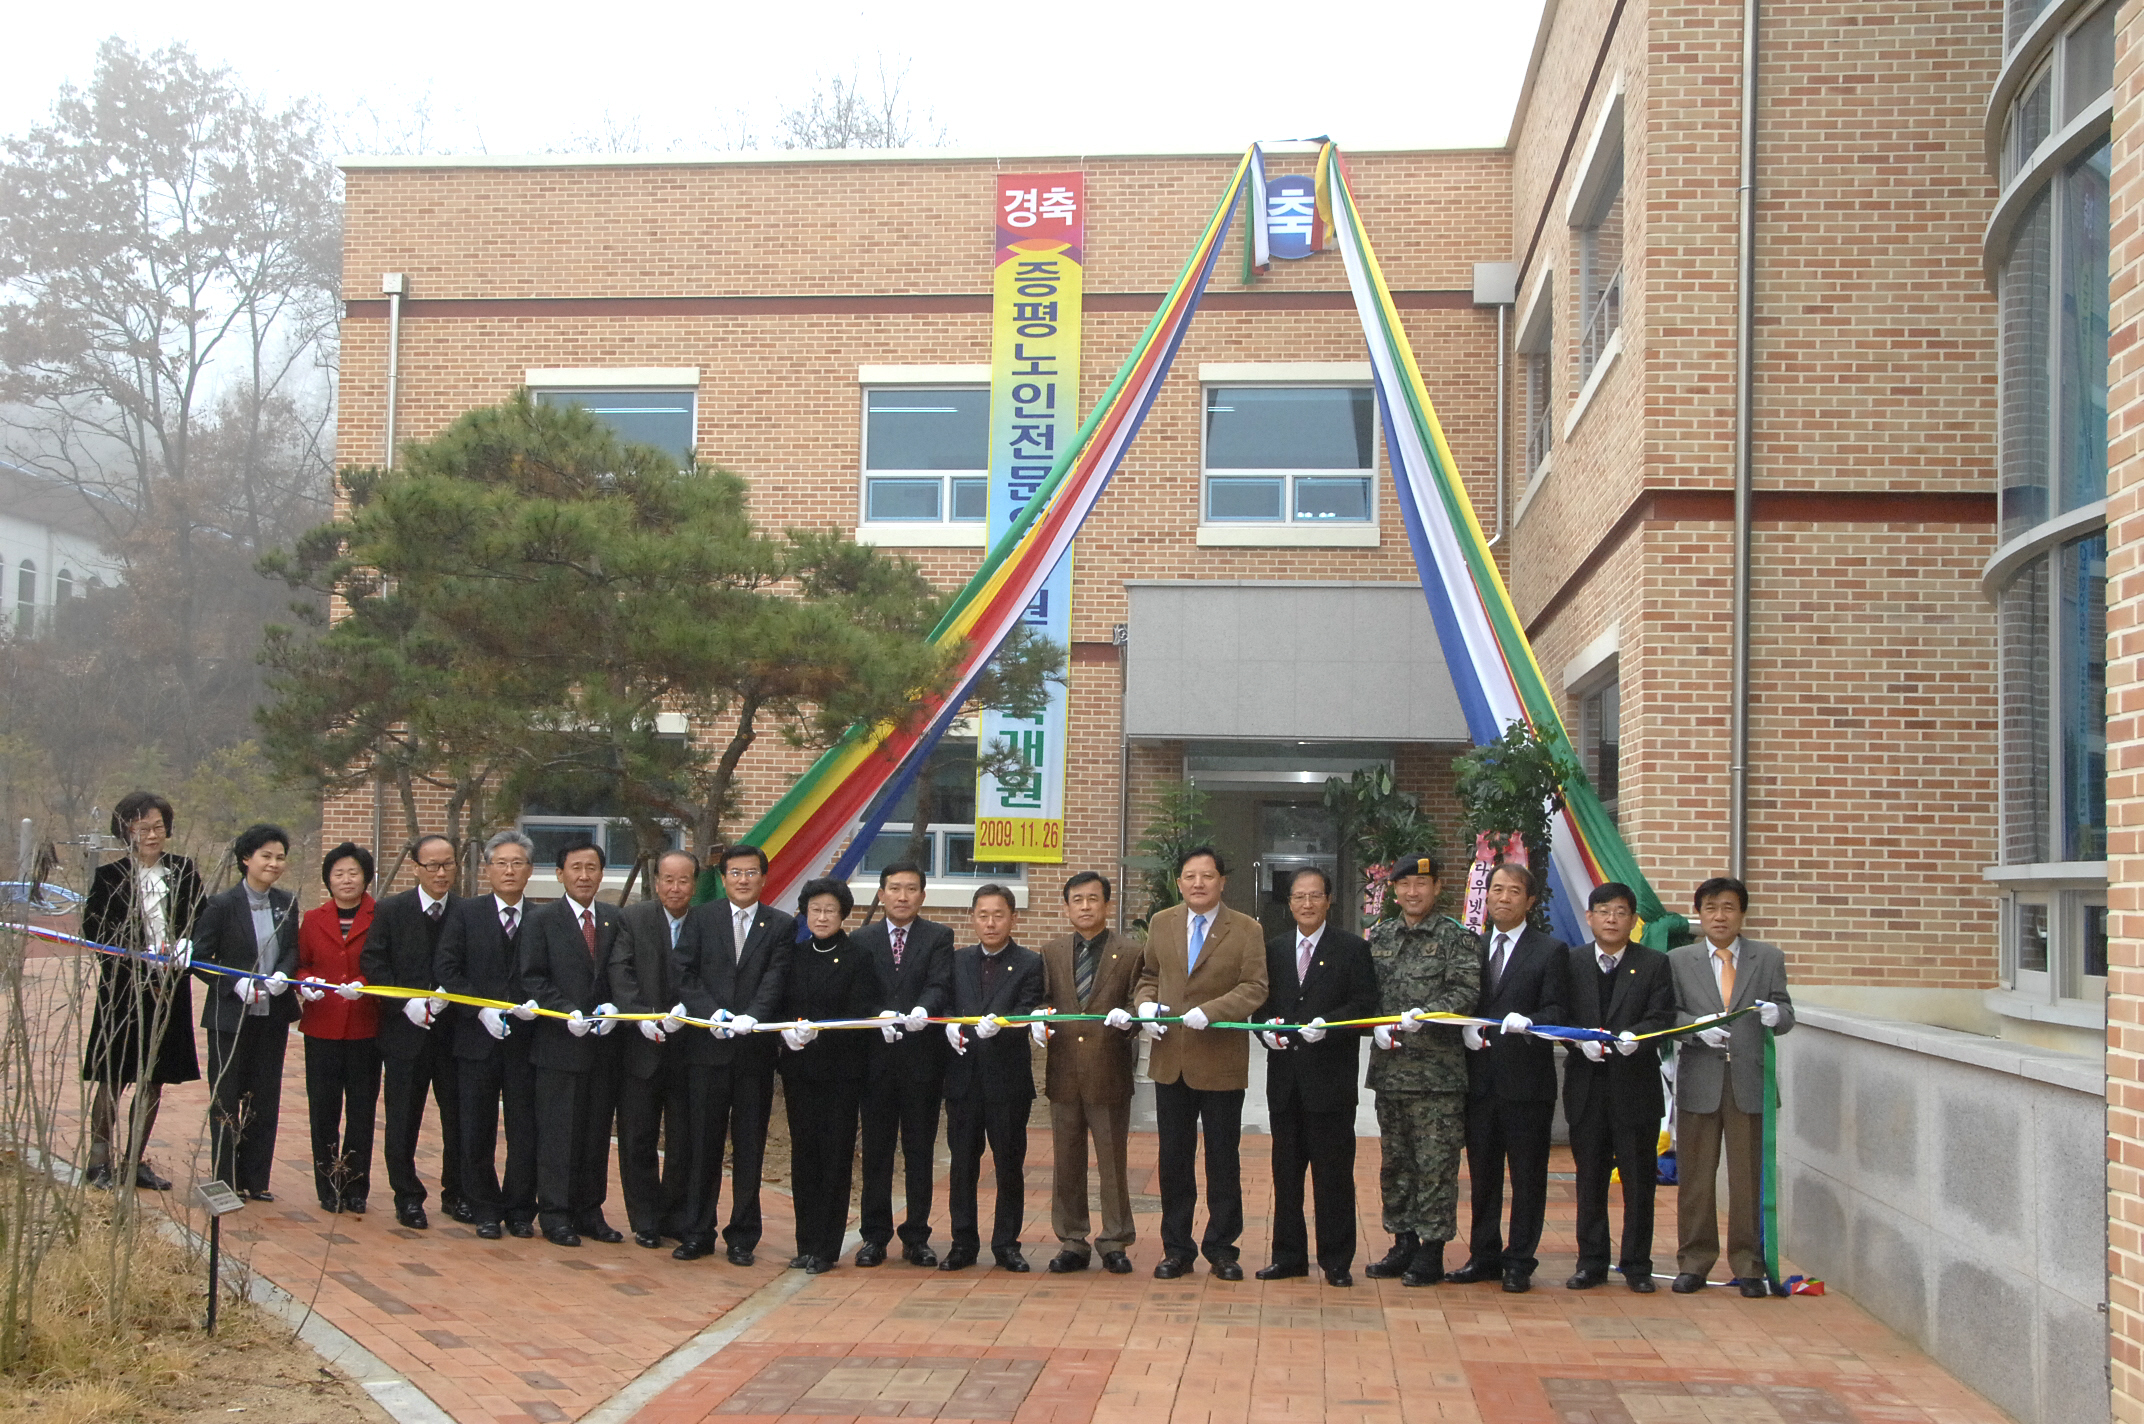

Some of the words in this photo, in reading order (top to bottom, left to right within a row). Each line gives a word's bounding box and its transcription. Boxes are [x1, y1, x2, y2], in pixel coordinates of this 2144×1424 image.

[1003, 186, 1077, 228] 경축
[1267, 188, 1315, 246] 축
[1007, 261, 1061, 626] 증평노인전문
[979, 820, 1015, 847] 2009.
[1020, 821, 1038, 848] 11.
[1042, 822, 1059, 849] 26
